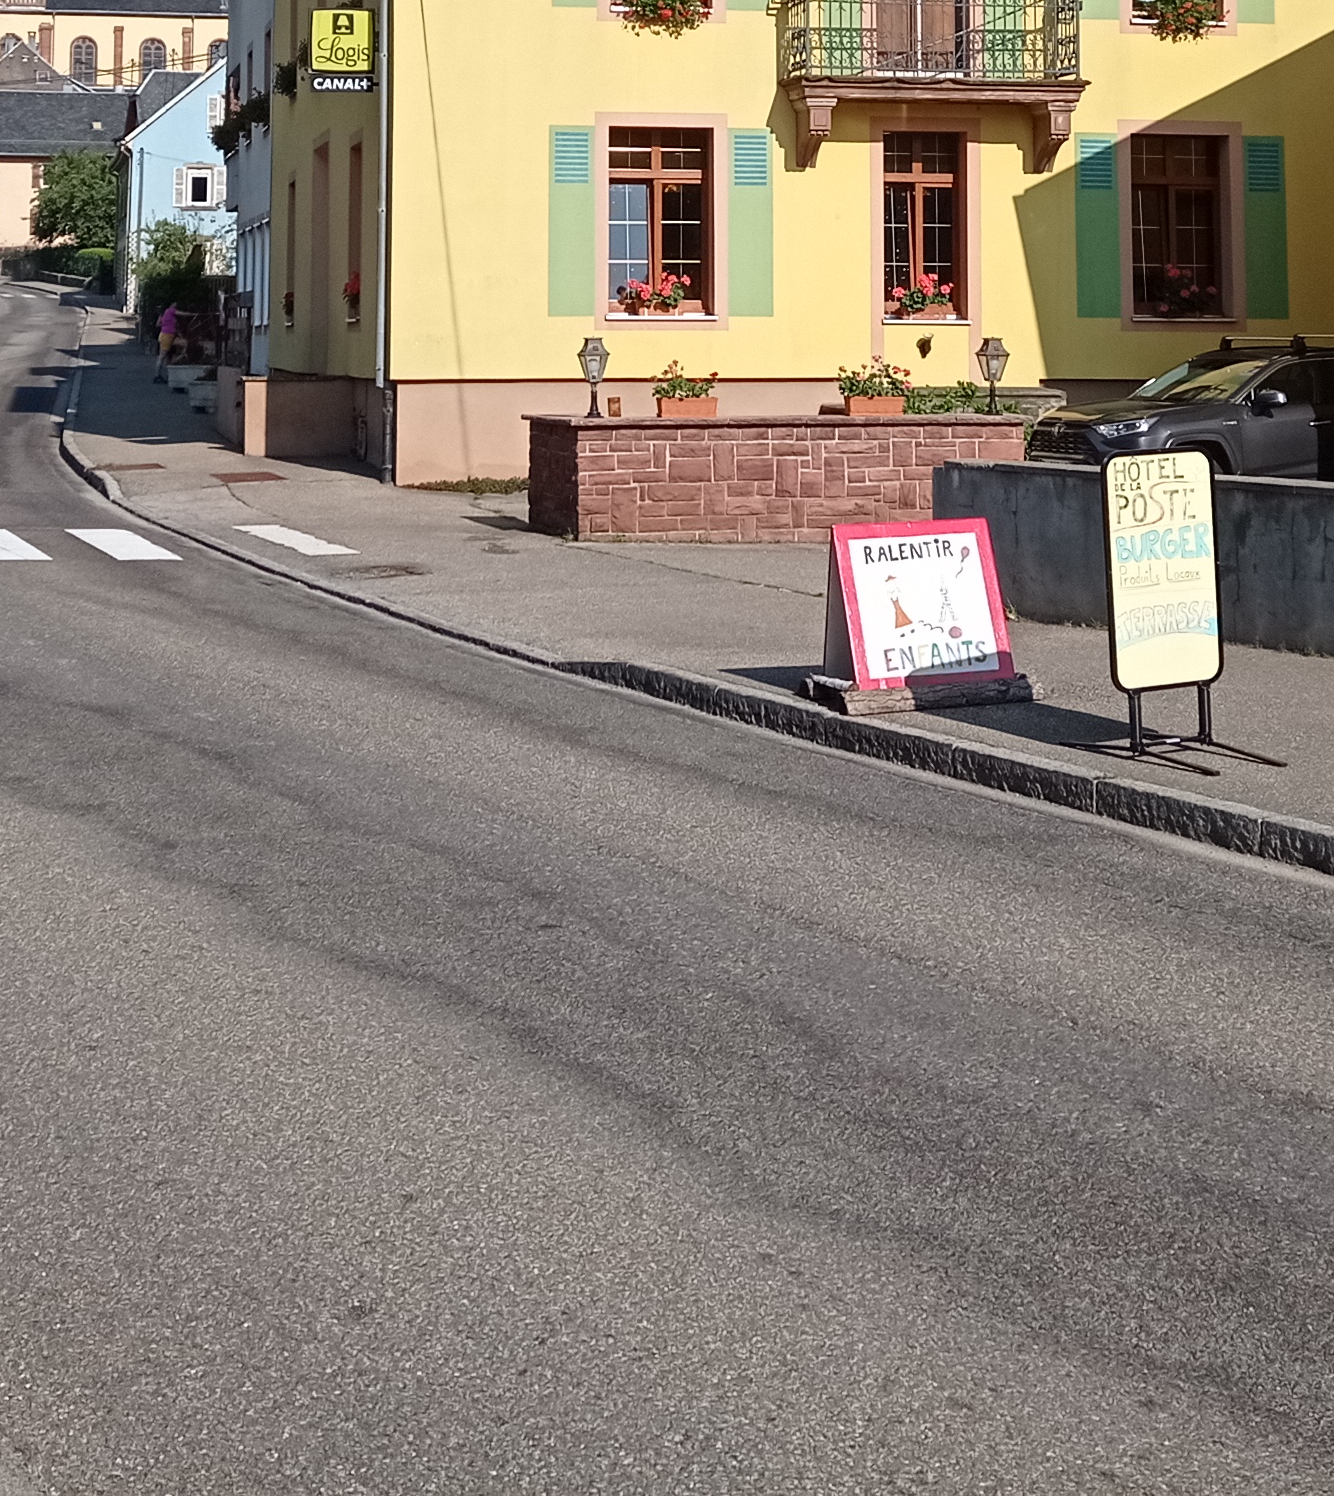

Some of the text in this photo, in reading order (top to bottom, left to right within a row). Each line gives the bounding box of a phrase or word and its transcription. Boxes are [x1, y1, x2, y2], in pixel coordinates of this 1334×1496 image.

[315, 36, 371, 67] Logis
[313, 77, 371, 90] CANAL+
[1113, 456, 1184, 482] HÔTEL
[1114, 482, 1141, 492] DE LA
[1114, 482, 1196, 528] POSTE
[1115, 523, 1211, 563] BURGER
[1117, 600, 1215, 642] TERRASSE
[884, 640, 987, 672] ENFANTS
